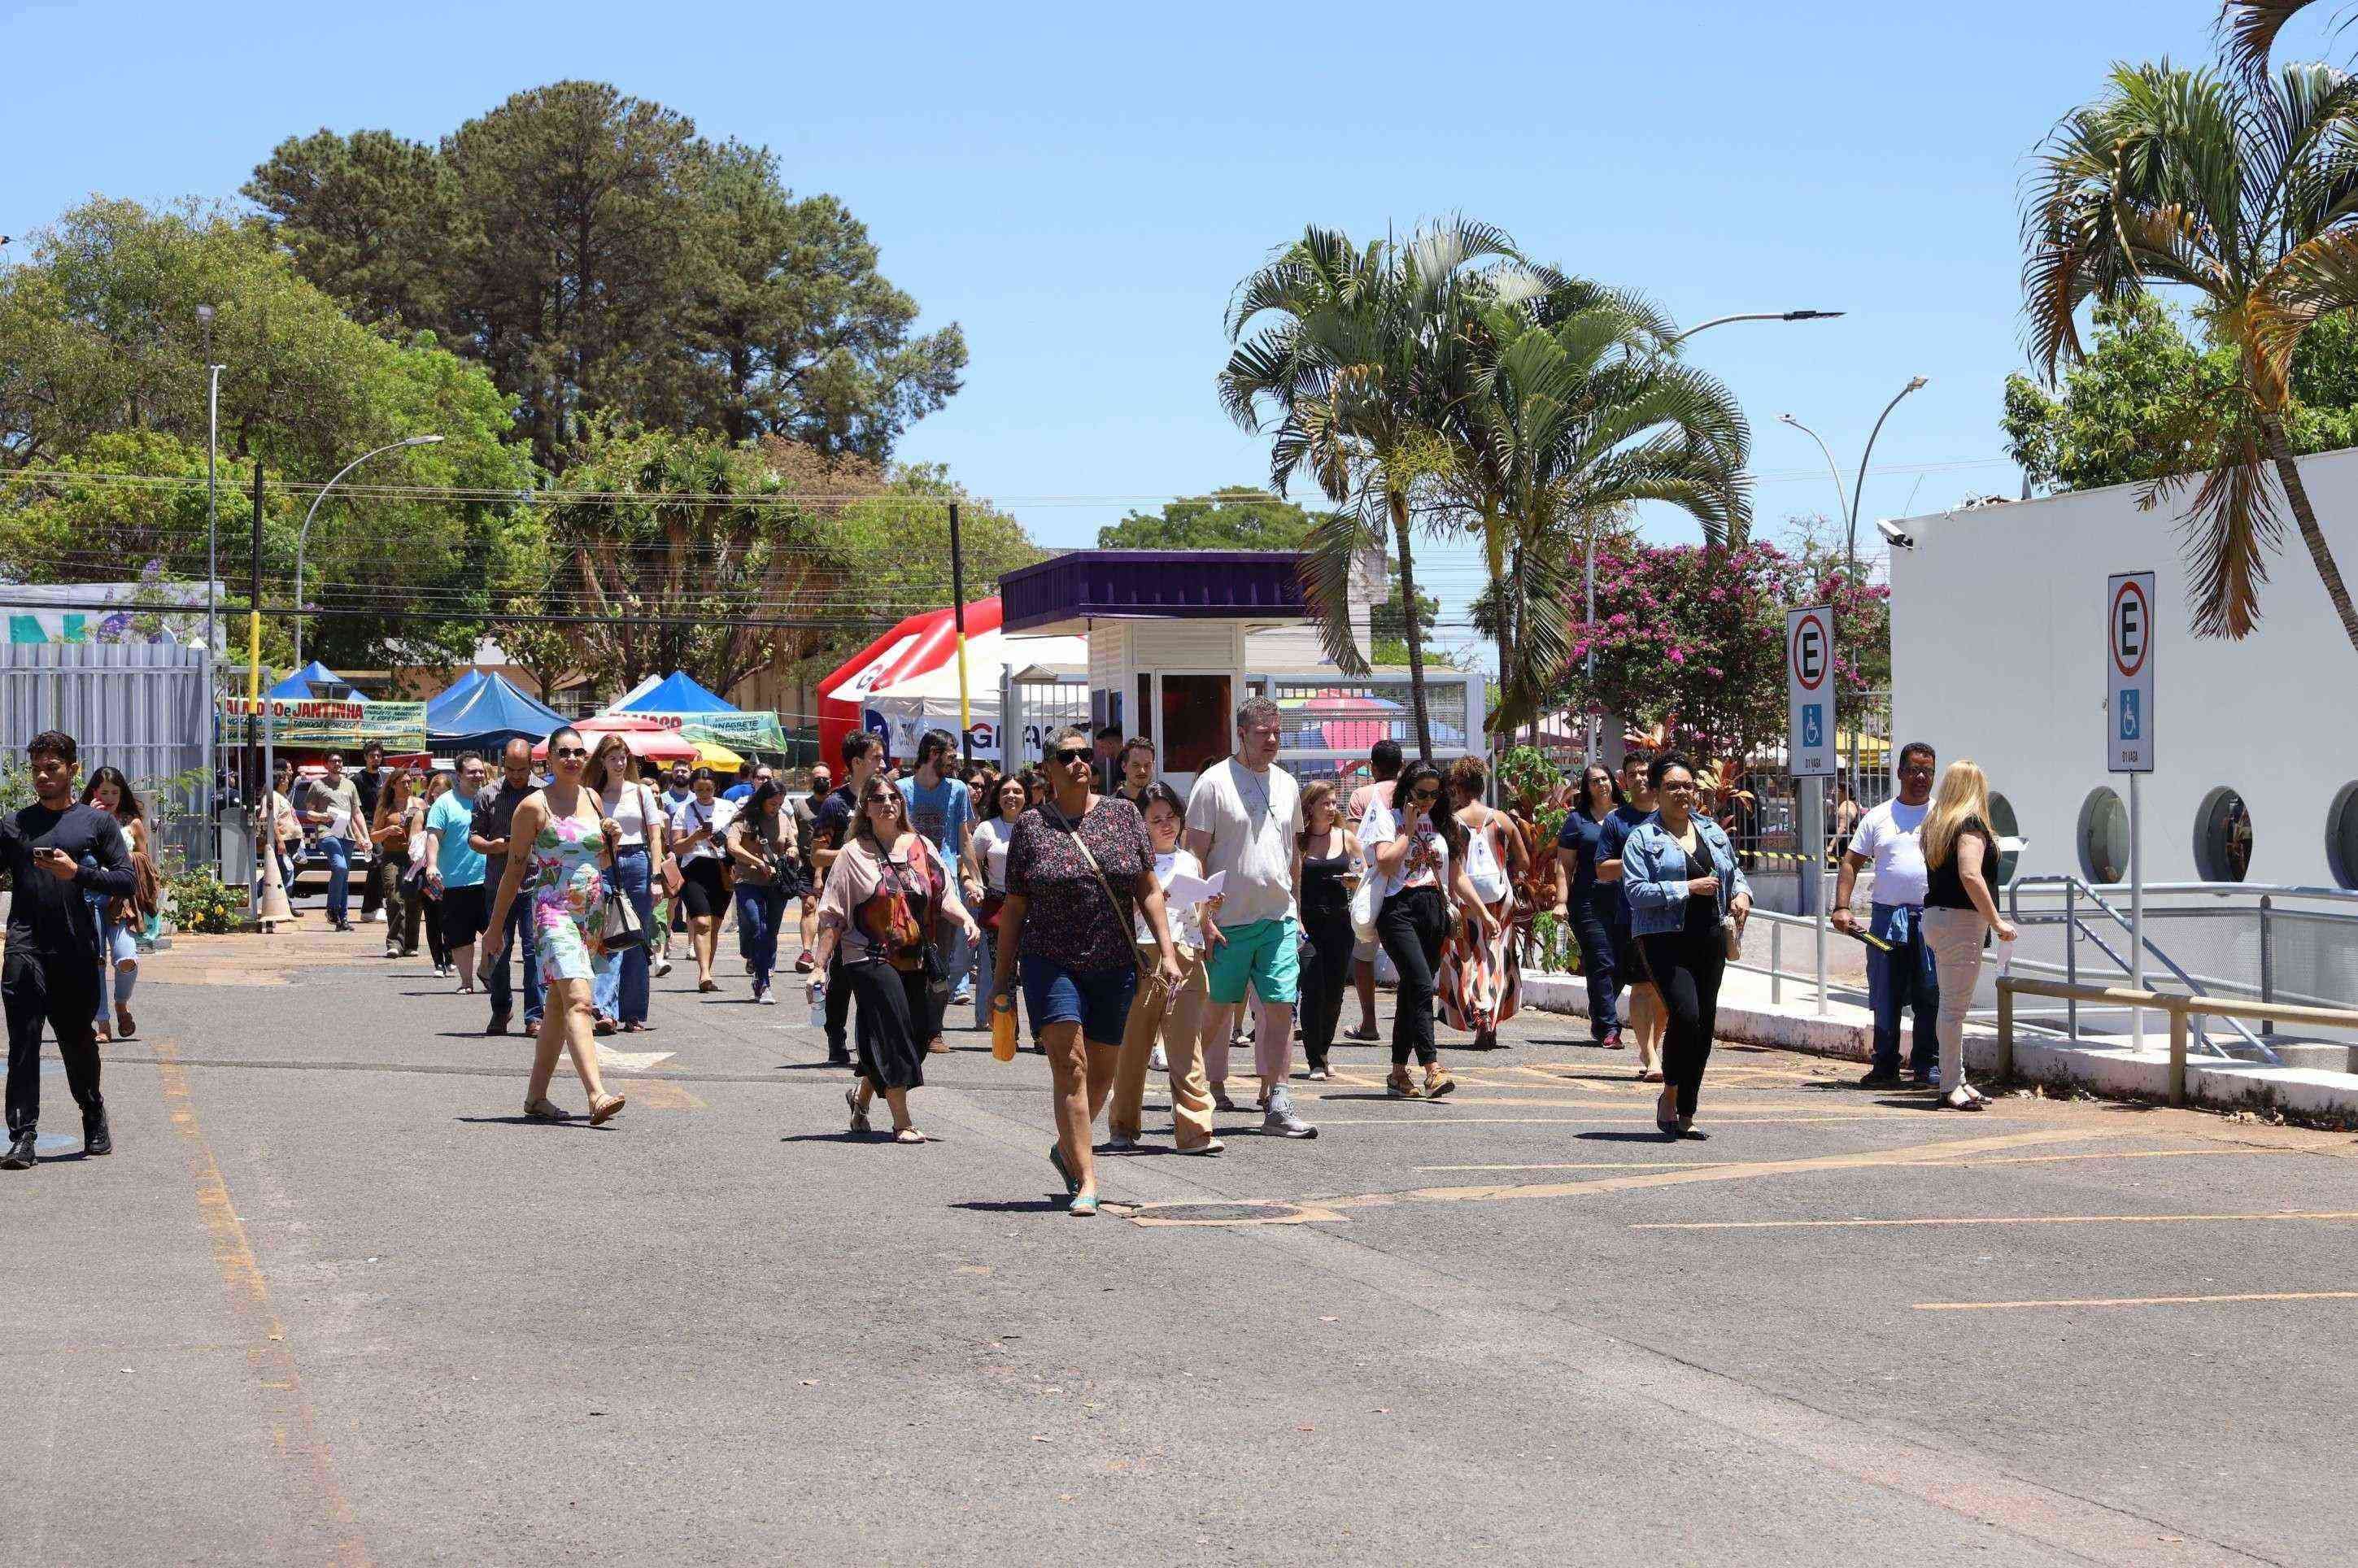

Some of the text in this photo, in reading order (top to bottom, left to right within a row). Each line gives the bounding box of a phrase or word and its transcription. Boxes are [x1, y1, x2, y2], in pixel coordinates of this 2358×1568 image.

[2122, 602, 2138, 656] E
[1803, 632, 1819, 677] E
[293, 702, 364, 720] JANTINHA
